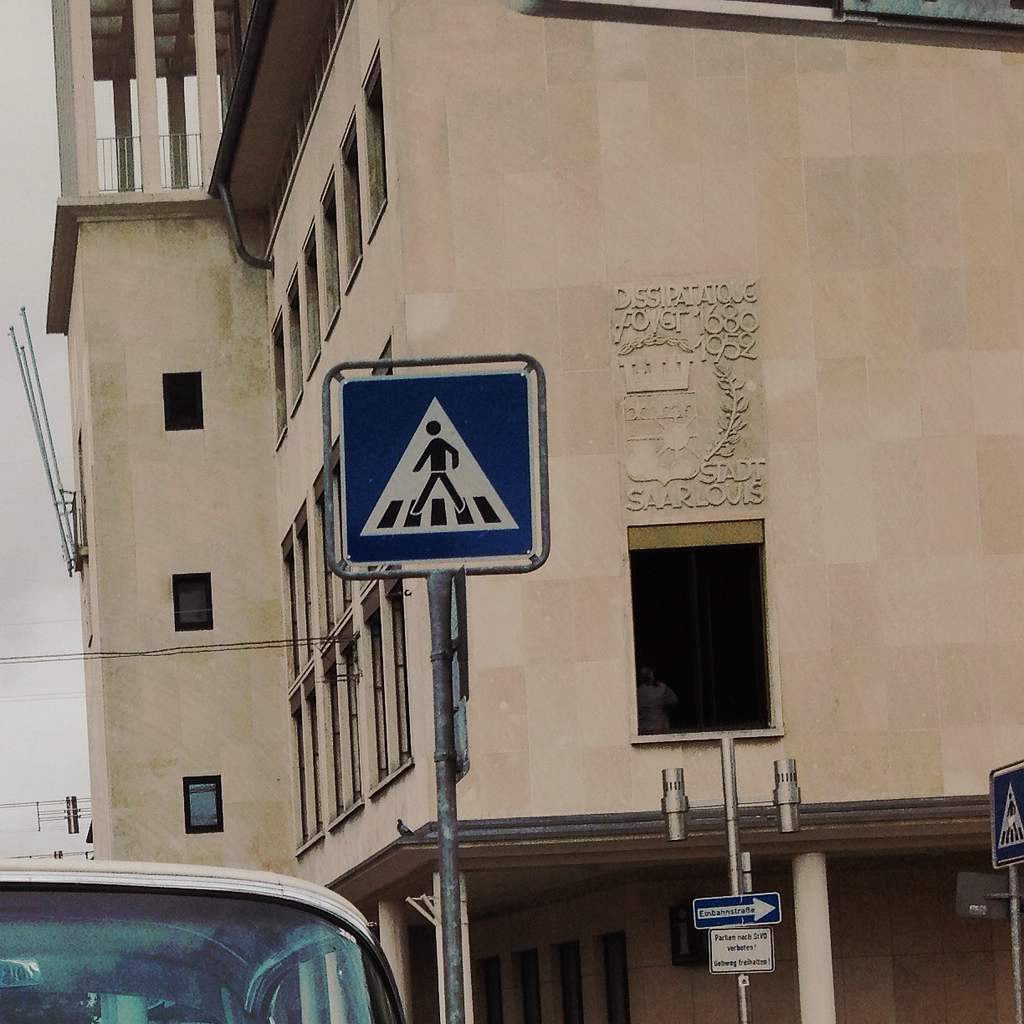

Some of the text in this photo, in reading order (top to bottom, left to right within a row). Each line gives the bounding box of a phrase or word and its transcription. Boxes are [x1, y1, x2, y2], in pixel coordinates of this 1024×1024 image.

[699, 461, 766, 485] STADT
[626, 484, 766, 512] SAARLOUIS
[699, 906, 755, 917] Einbahnstraße
